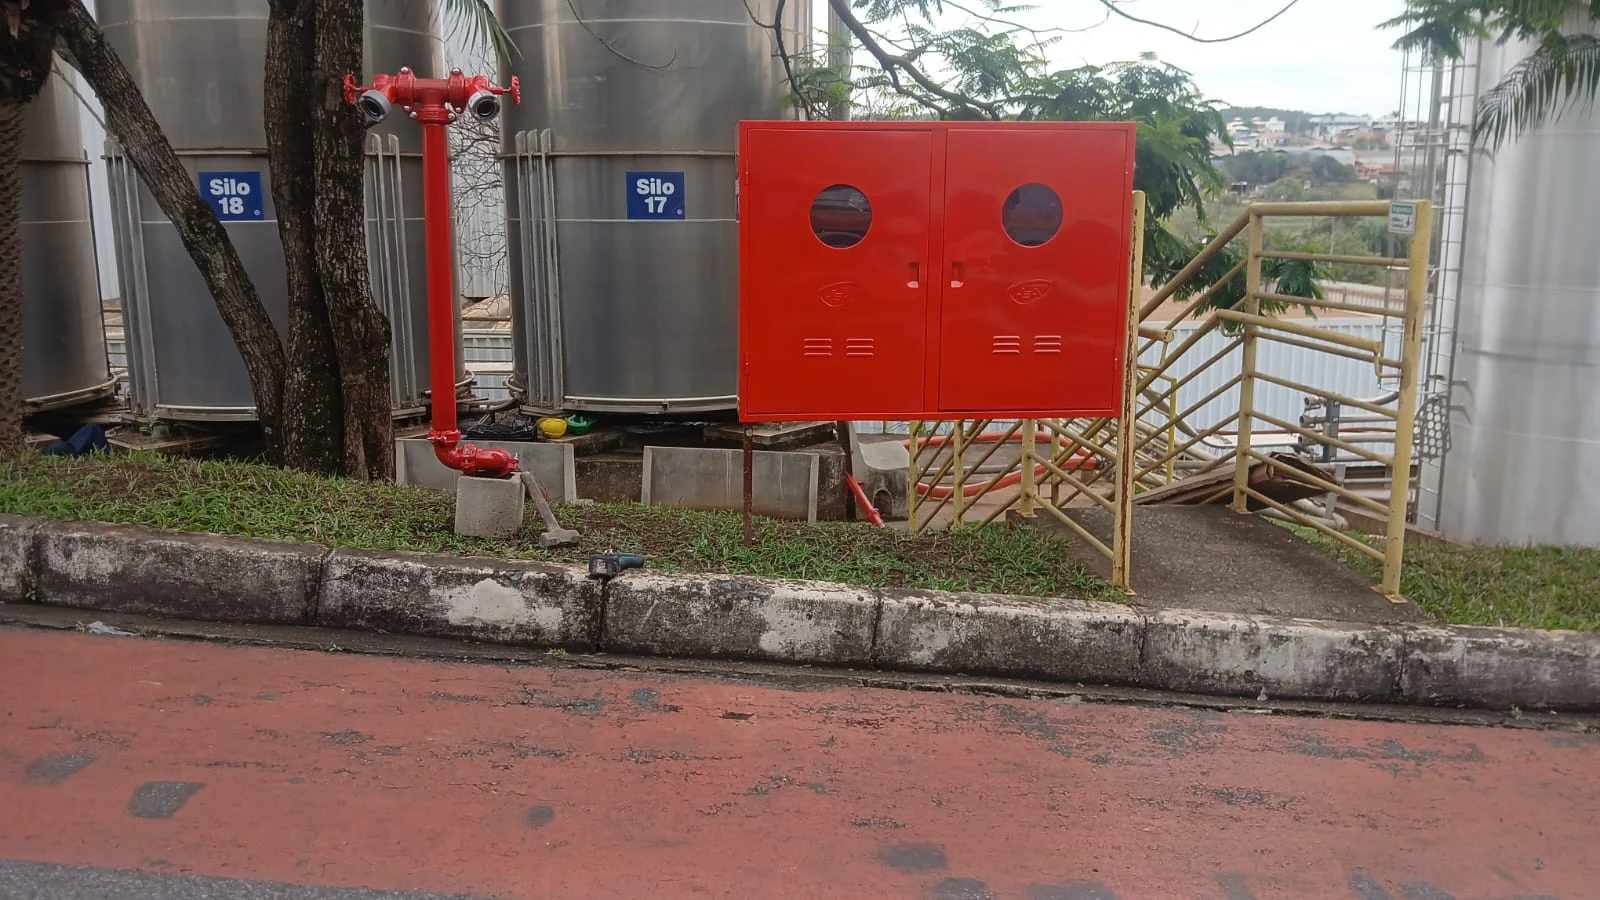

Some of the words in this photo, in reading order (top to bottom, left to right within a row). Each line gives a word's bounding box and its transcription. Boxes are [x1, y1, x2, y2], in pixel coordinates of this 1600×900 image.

[210, 178, 250, 195] Silo
[636, 178, 675, 195] Silo
[218, 197, 244, 214] 18
[644, 196, 667, 213] 17
